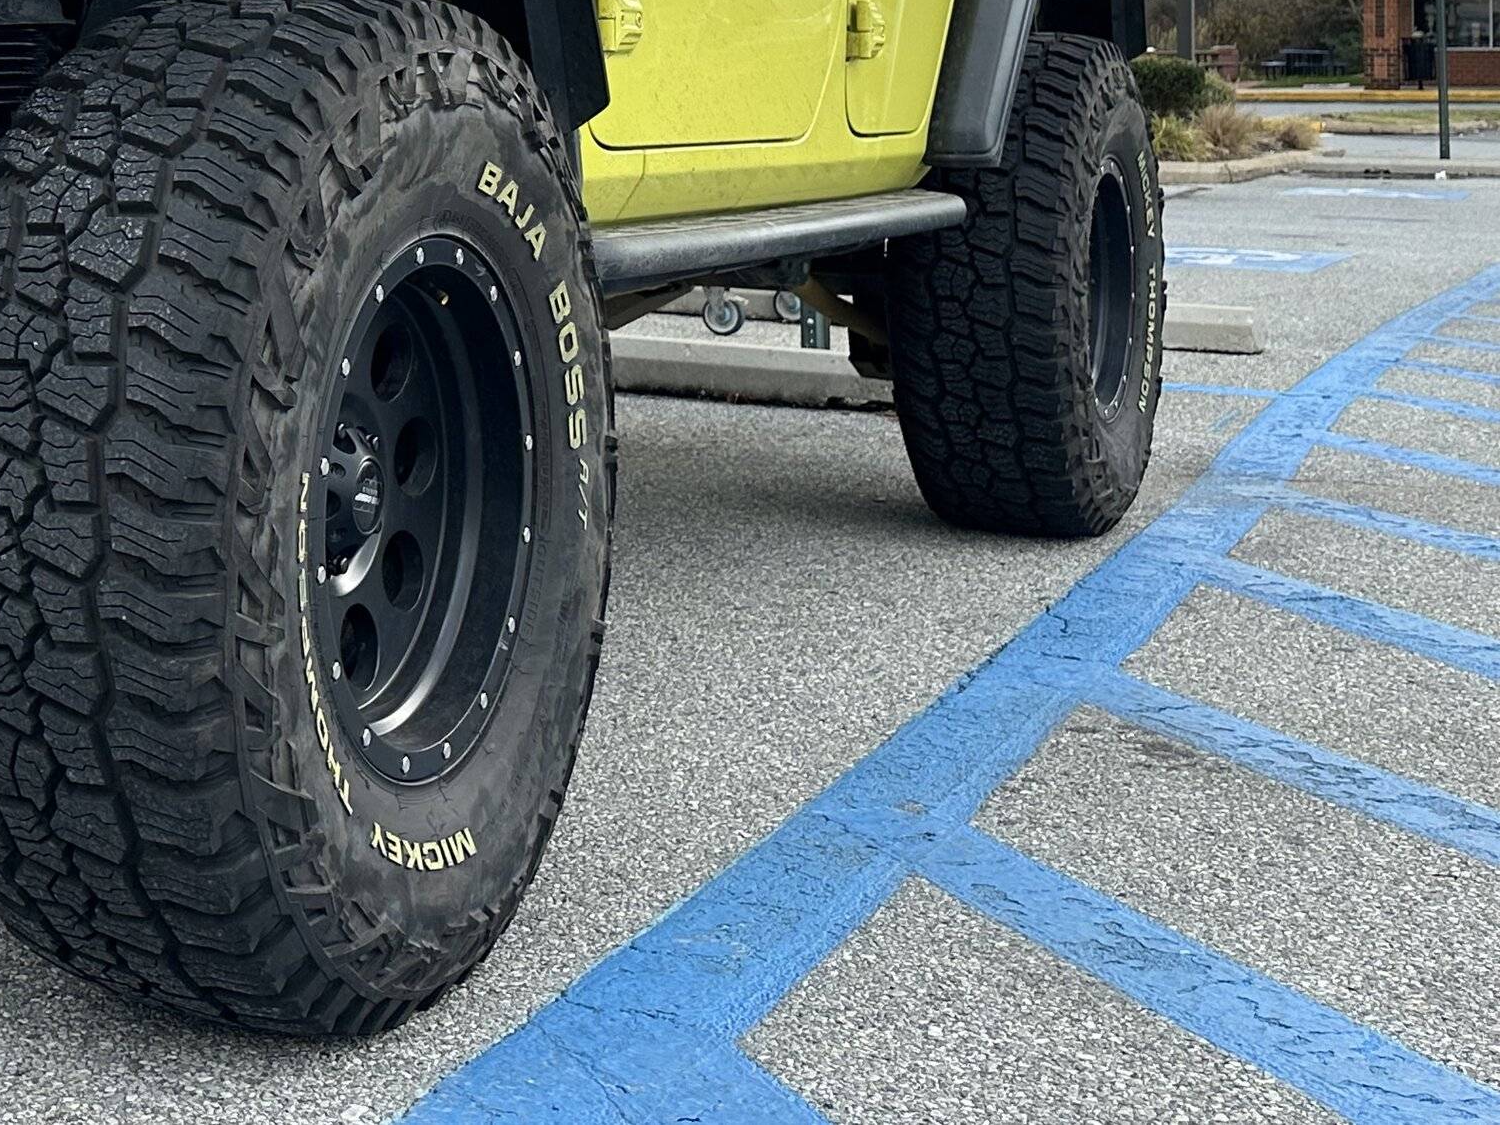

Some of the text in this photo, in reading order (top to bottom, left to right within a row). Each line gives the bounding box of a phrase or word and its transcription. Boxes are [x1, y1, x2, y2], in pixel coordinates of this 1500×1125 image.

[477, 161, 589, 530] BAJA BOSS A/T
[298, 472, 477, 871] MICKEY THOMPSON
